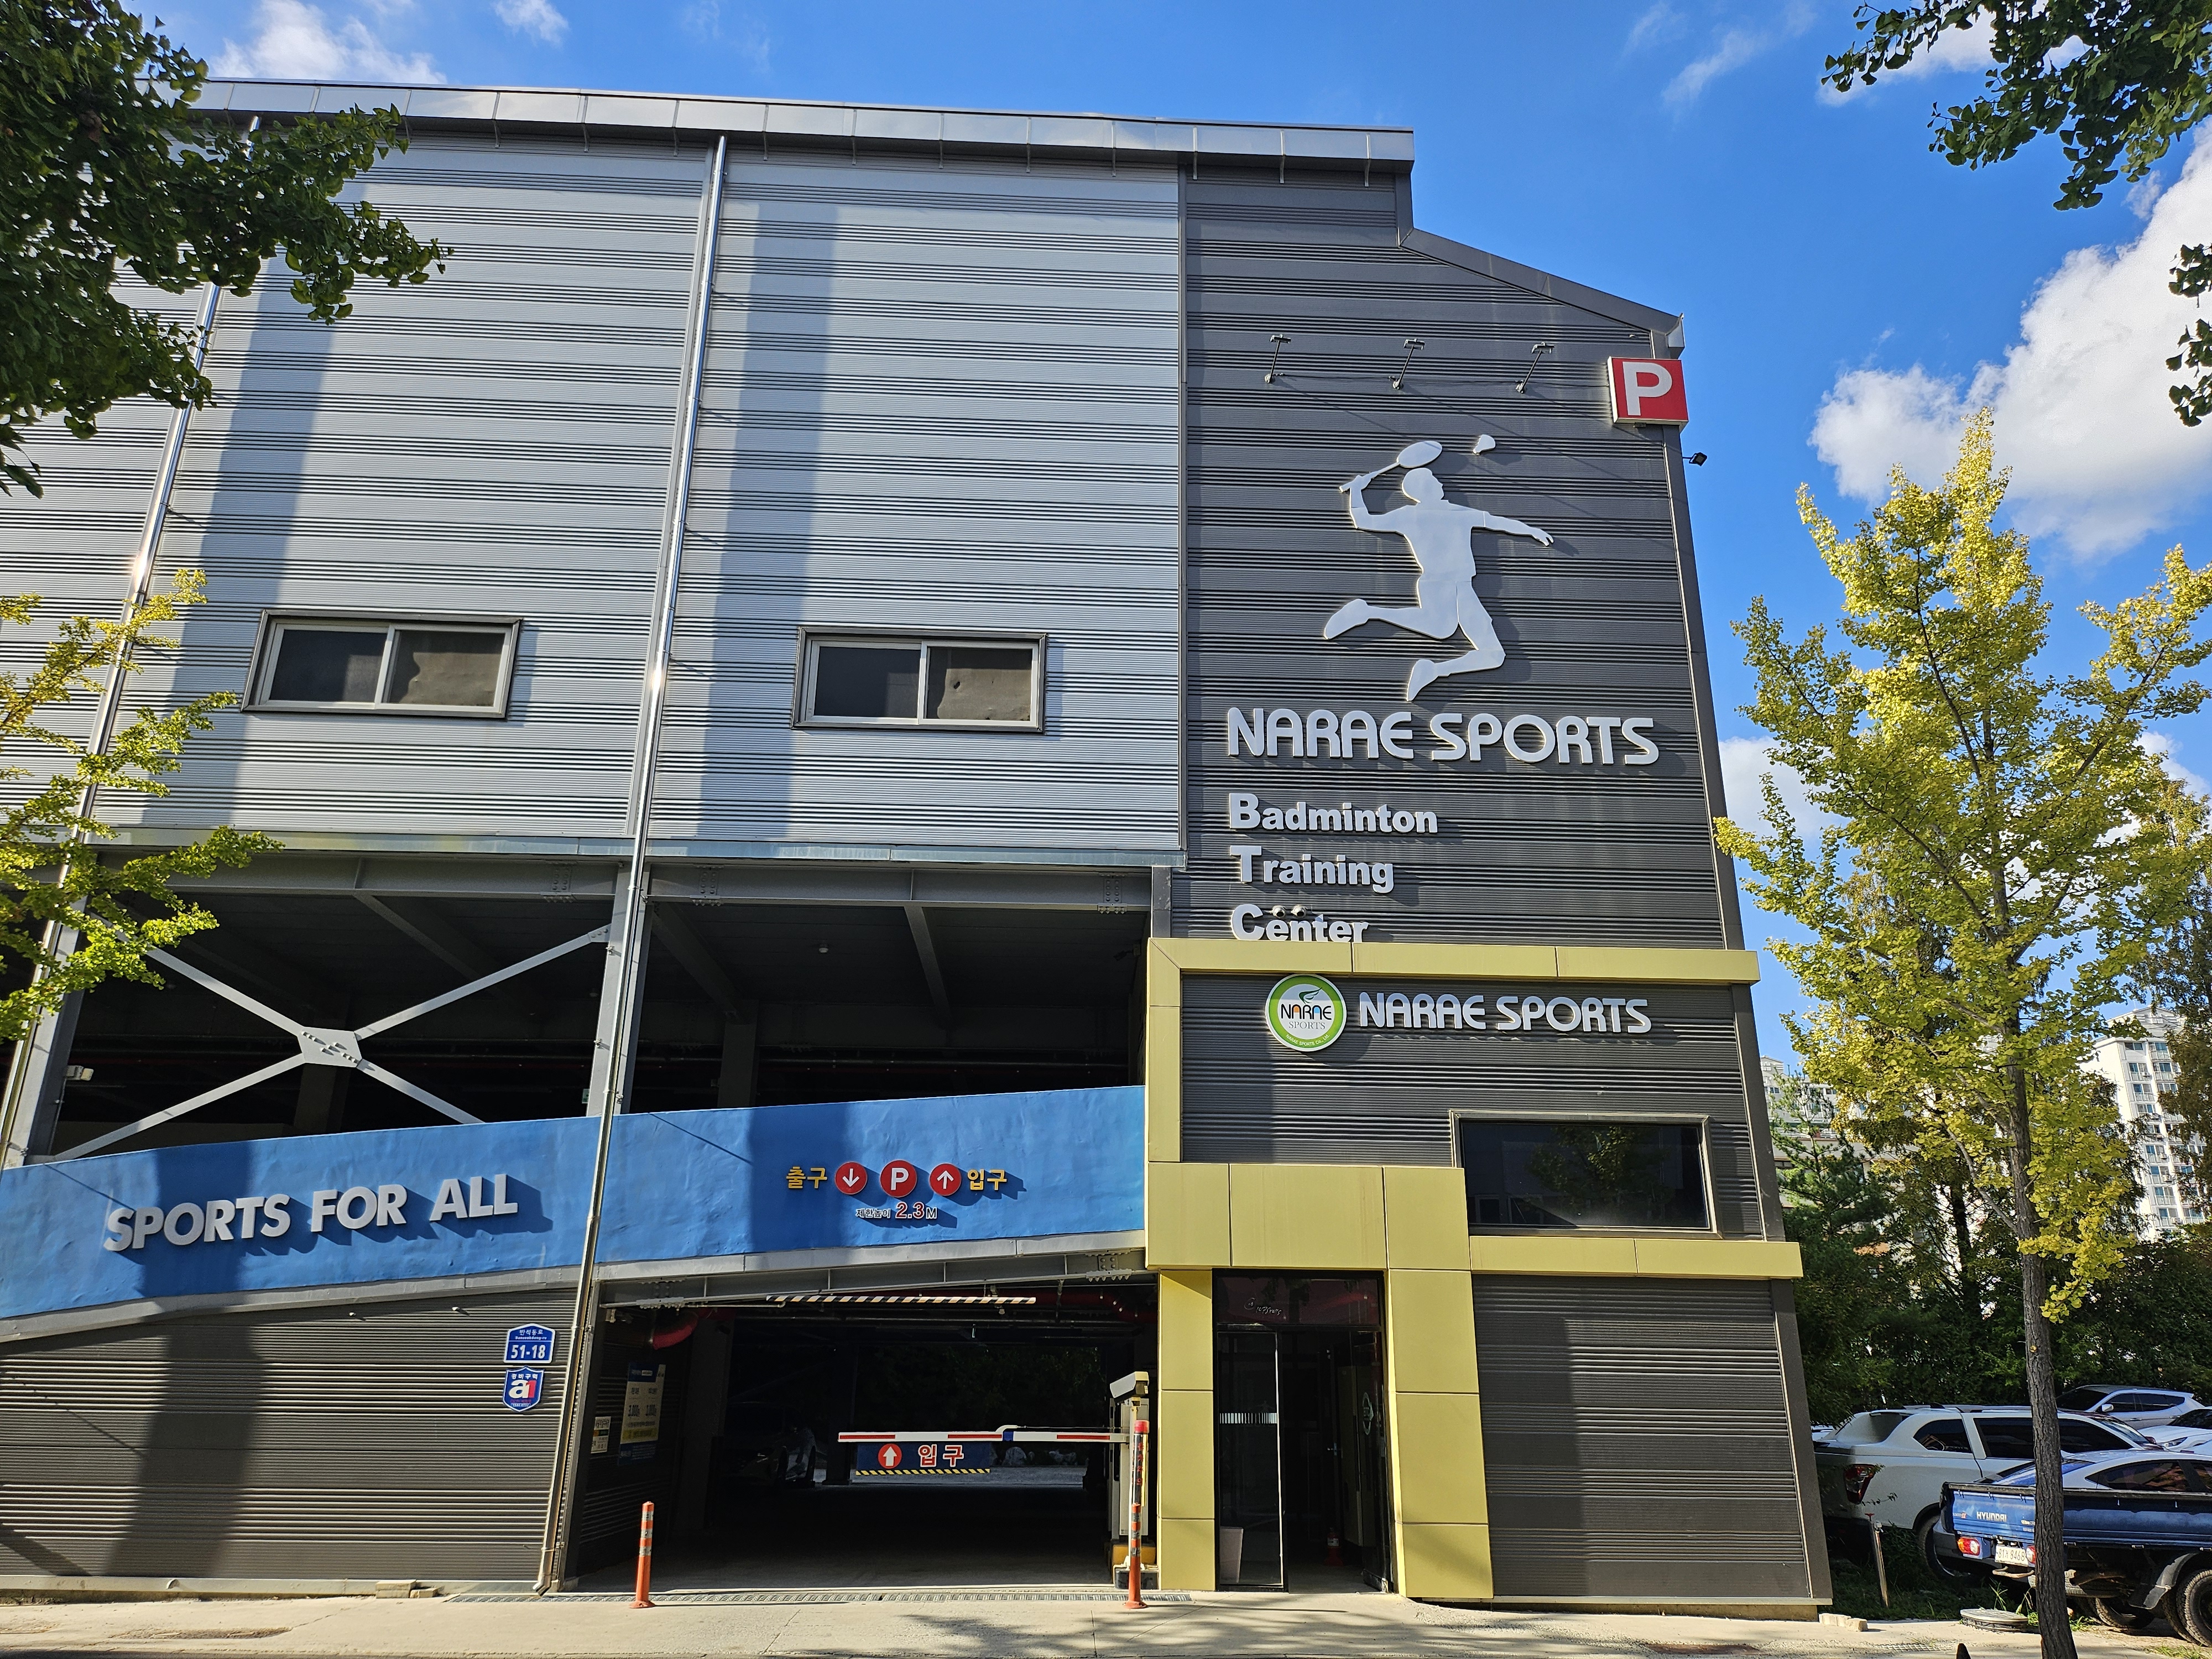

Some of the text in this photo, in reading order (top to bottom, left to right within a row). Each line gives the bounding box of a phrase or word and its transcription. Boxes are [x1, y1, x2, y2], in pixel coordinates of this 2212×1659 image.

[1623, 361, 1672, 416] P
[1228, 707, 1660, 765] NARAE SPORTS
[1228, 793, 1438, 833] Badminton
[1230, 846, 1394, 894] Training
[1232, 904, 1369, 943] Center
[1281, 1004, 1332, 1020] NARAE
[1359, 992, 1652, 1034] NARAE SPORTS
[1288, 1021, 1326, 1030] SPORTS
[1286, 1034, 1298, 1044] NARAE
[786, 1166, 1008, 1191] 출구 P 입구
[103, 1174, 519, 1251] SPORTS FOR ALL
[855, 1207, 891, 1219] 제한높이
[510, 1344, 546, 1359] 51-18
[918, 1443, 964, 1467] 입구
[1976, 1511, 2007, 1522] HYUNDAI
